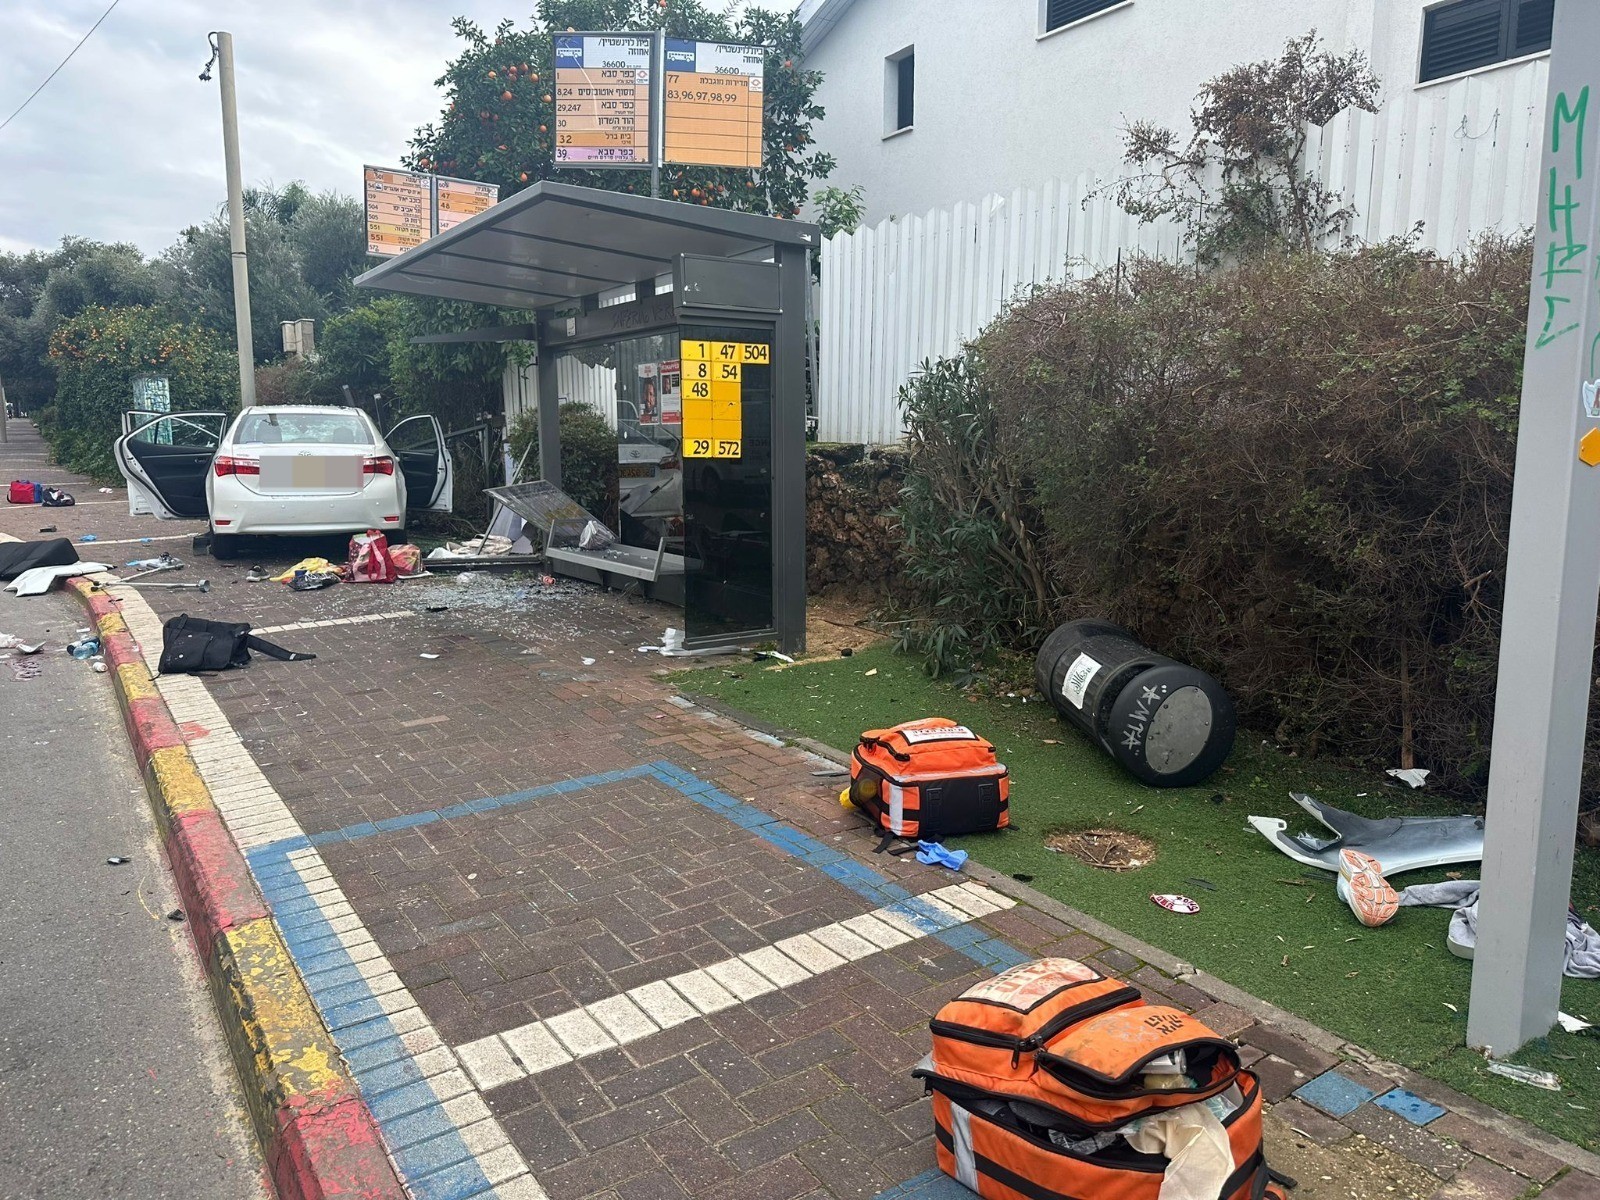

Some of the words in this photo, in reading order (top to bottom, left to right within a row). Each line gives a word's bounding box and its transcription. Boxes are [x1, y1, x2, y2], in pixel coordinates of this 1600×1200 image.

[628, 47, 649, 56] אחוזה
[601, 70, 618, 78] סבא
[619, 70, 635, 78] כפר
[715, 66, 739, 75] 36600
[557, 72, 560, 80] 1
[667, 75, 680, 83] 77
[699, 77, 724, 85] מוגבלת
[725, 79, 748, 87] תדירות
[557, 88, 573, 97] 8,24
[577, 88, 614, 96] אוטובוסים
[615, 88, 635, 97] מסוף
[557, 104, 581, 112] 29,247
[601, 101, 617, 109] סבא
[619, 101, 634, 109] כפר
[598, 117, 620, 126] השרון
[559, 134, 573, 144] 32
[605, 132, 618, 140] ברל
[698, 343, 705, 358] 1
[720, 344, 736, 360] 47
[744, 345, 767, 360] 504
[698, 363, 707, 378] 8
[721, 364, 738, 380] 54
[691, 382, 709, 398] 48
[693, 440, 710, 455] 29
[718, 441, 740, 456] 572
